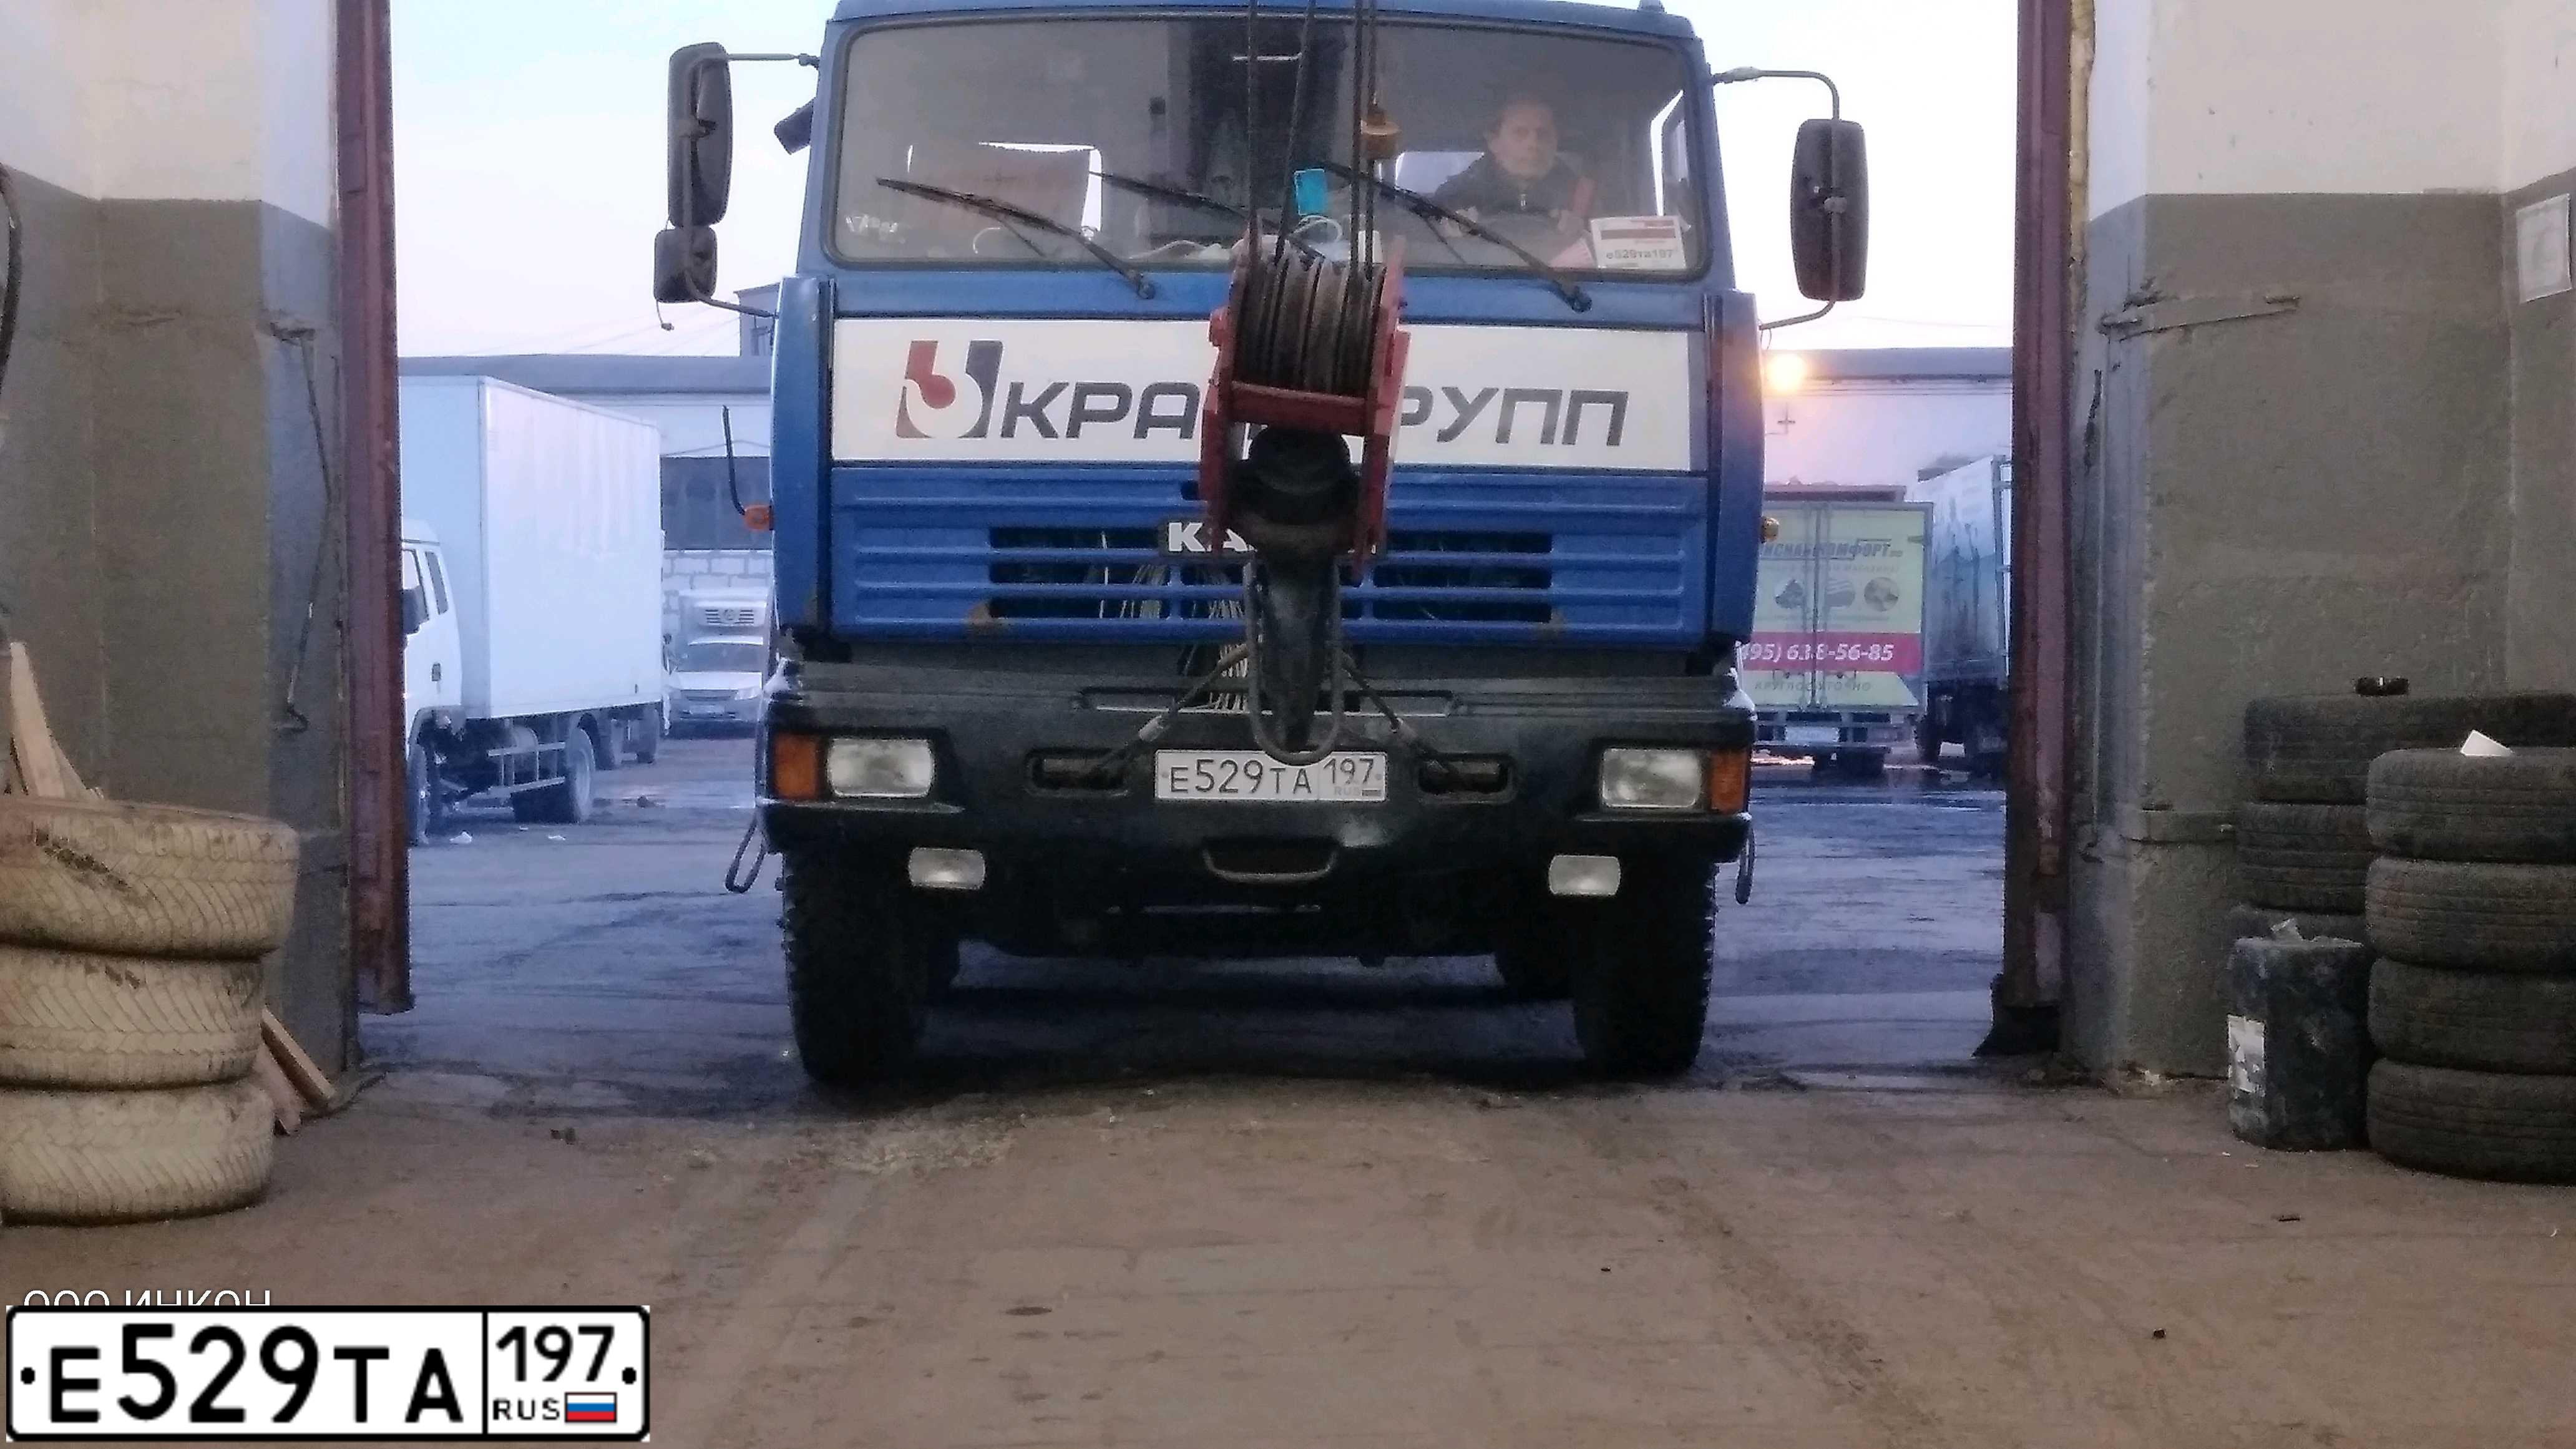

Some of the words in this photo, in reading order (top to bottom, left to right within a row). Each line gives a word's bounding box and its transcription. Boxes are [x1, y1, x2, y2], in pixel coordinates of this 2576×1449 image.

[1000, 381, 1202, 439] КРА
[1400, 385, 1629, 447] РУПП
[1170, 758, 1312, 794] Е529ТА
[1323, 758, 1374, 784] 197
